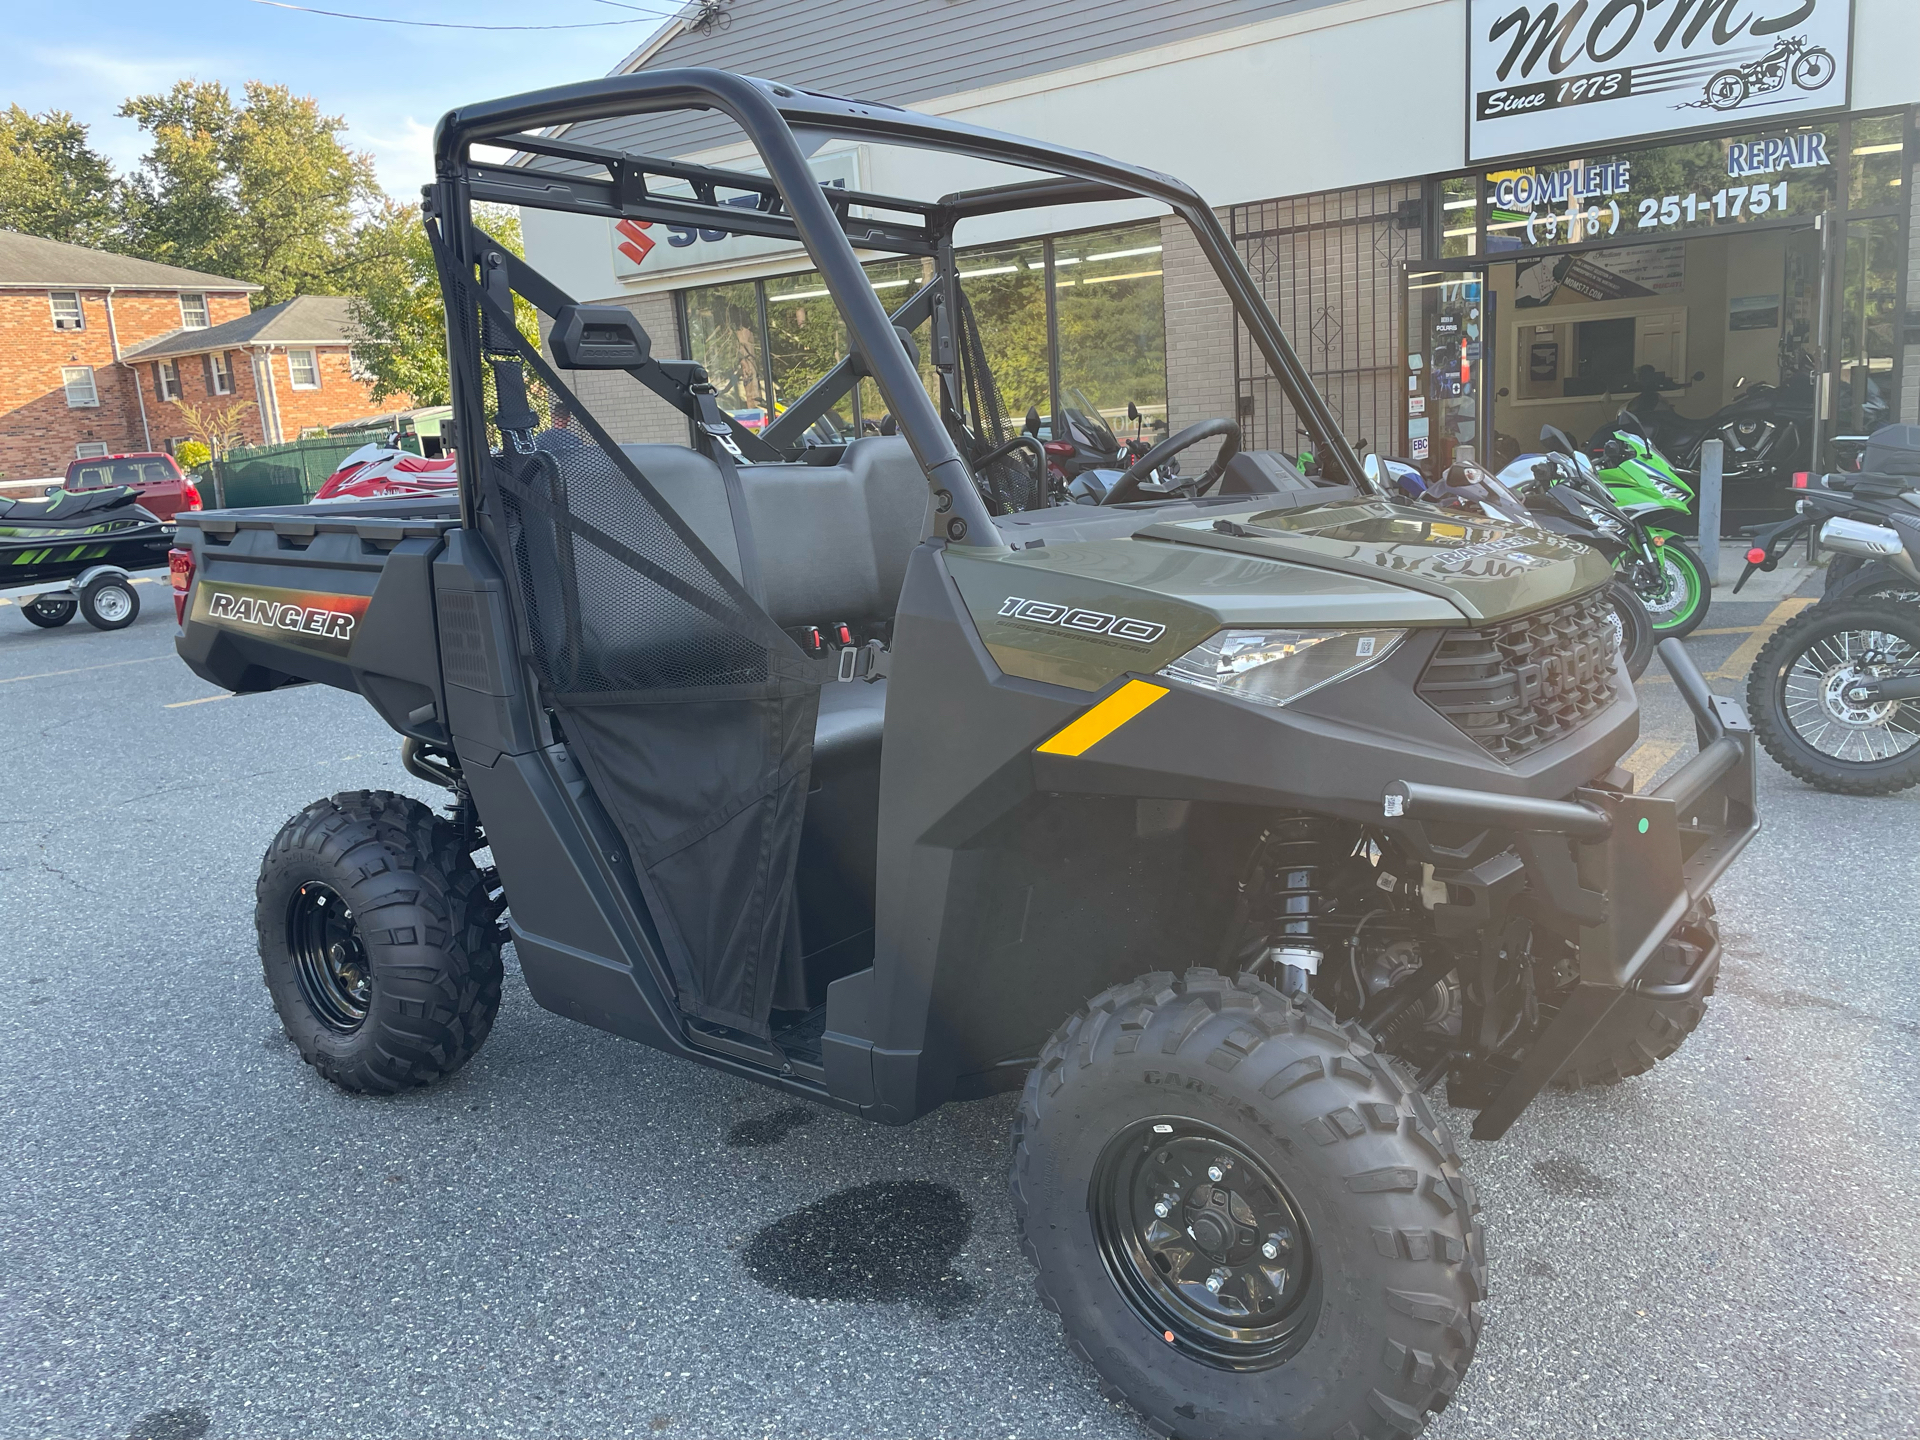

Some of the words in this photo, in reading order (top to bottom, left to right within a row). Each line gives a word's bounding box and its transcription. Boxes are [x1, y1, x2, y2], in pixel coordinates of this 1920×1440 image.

[1484, 90, 1546, 115] Since
[1556, 73, 1622, 103] 1973
[1495, 161, 1630, 209] COMPLETE
[1727, 132, 1831, 178] REPAIR
[1637, 181, 1788, 228] 251-1751
[1564, 277, 1603, 300] MOMS73.COM
[1413, 439, 1428, 450] EBC
[1432, 535, 1540, 565] RANGER
[209, 592, 356, 640] RANGER
[997, 596, 1167, 643] 1000
[995, 620, 1045, 633] SINGLE
[1046, 629, 1118, 647] OVERHEAD
[1118, 644, 1151, 655] CAM
